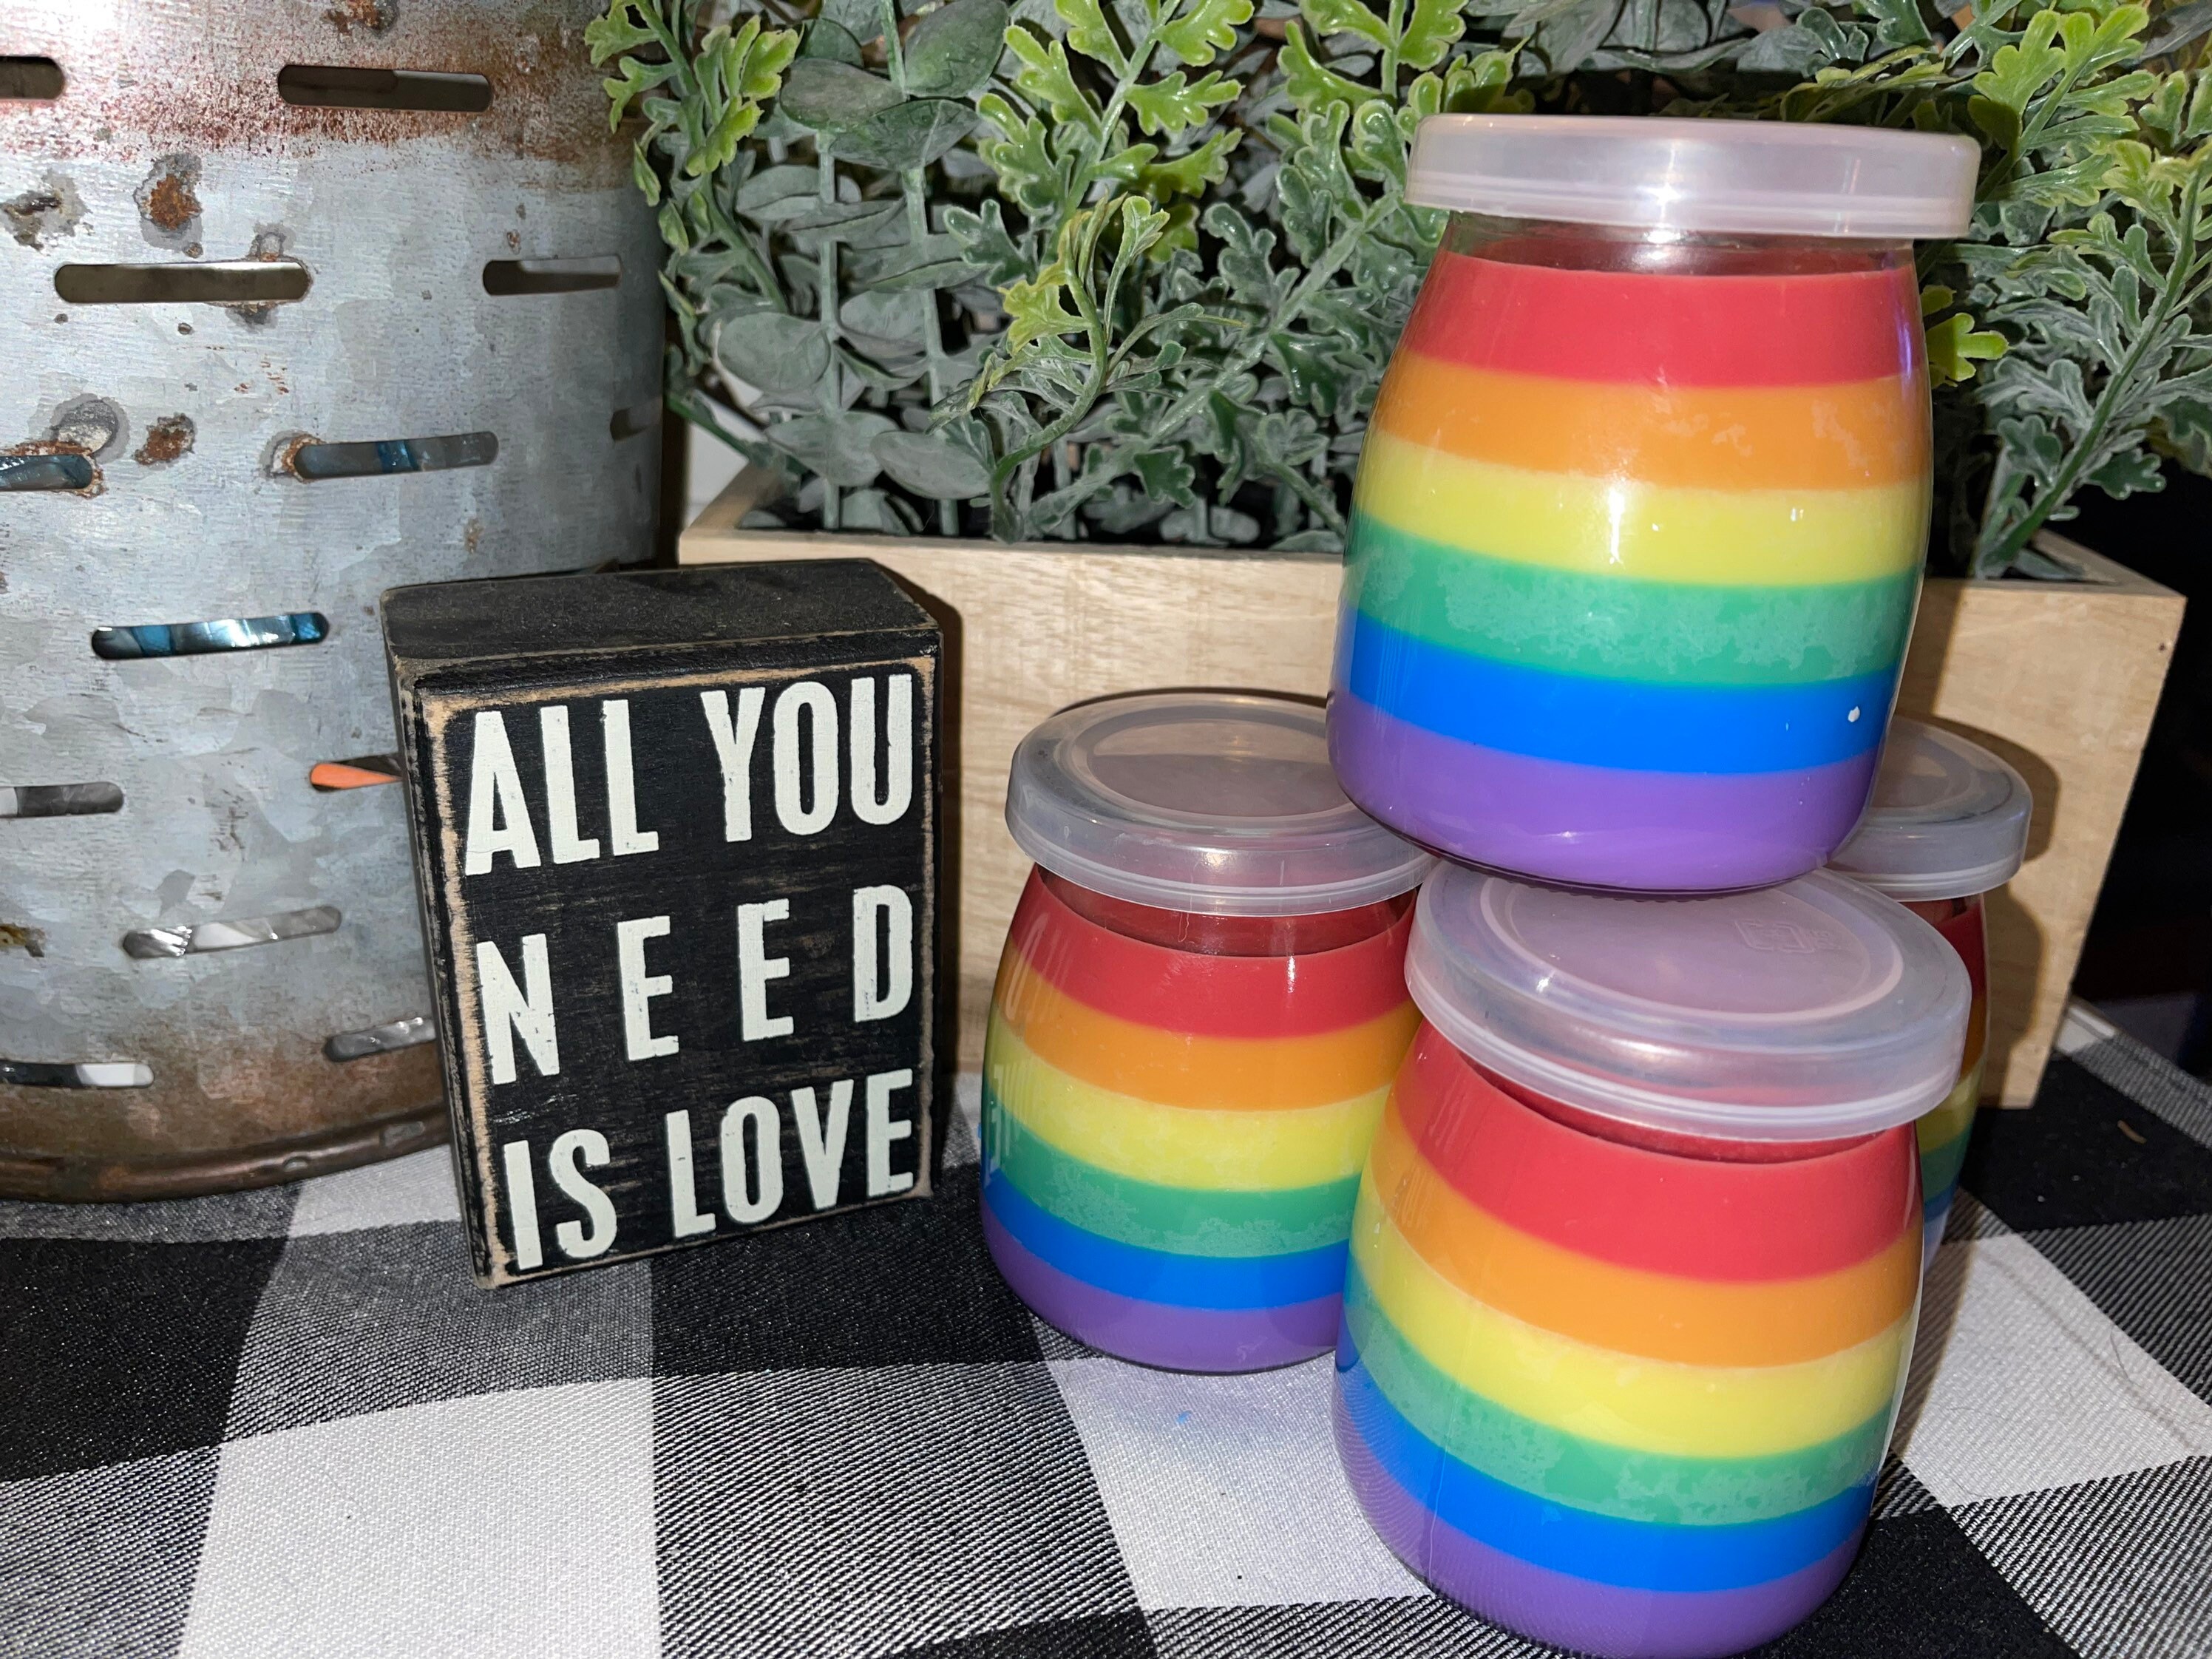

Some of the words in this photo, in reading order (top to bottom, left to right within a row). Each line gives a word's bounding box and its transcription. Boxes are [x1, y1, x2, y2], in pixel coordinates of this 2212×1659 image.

[465, 699, 659, 876] ALL
[700, 674, 913, 843] YOU
[475, 884, 913, 1085] NEED
[504, 1129, 617, 1270] IS
[666, 1069, 915, 1238] LOVE
